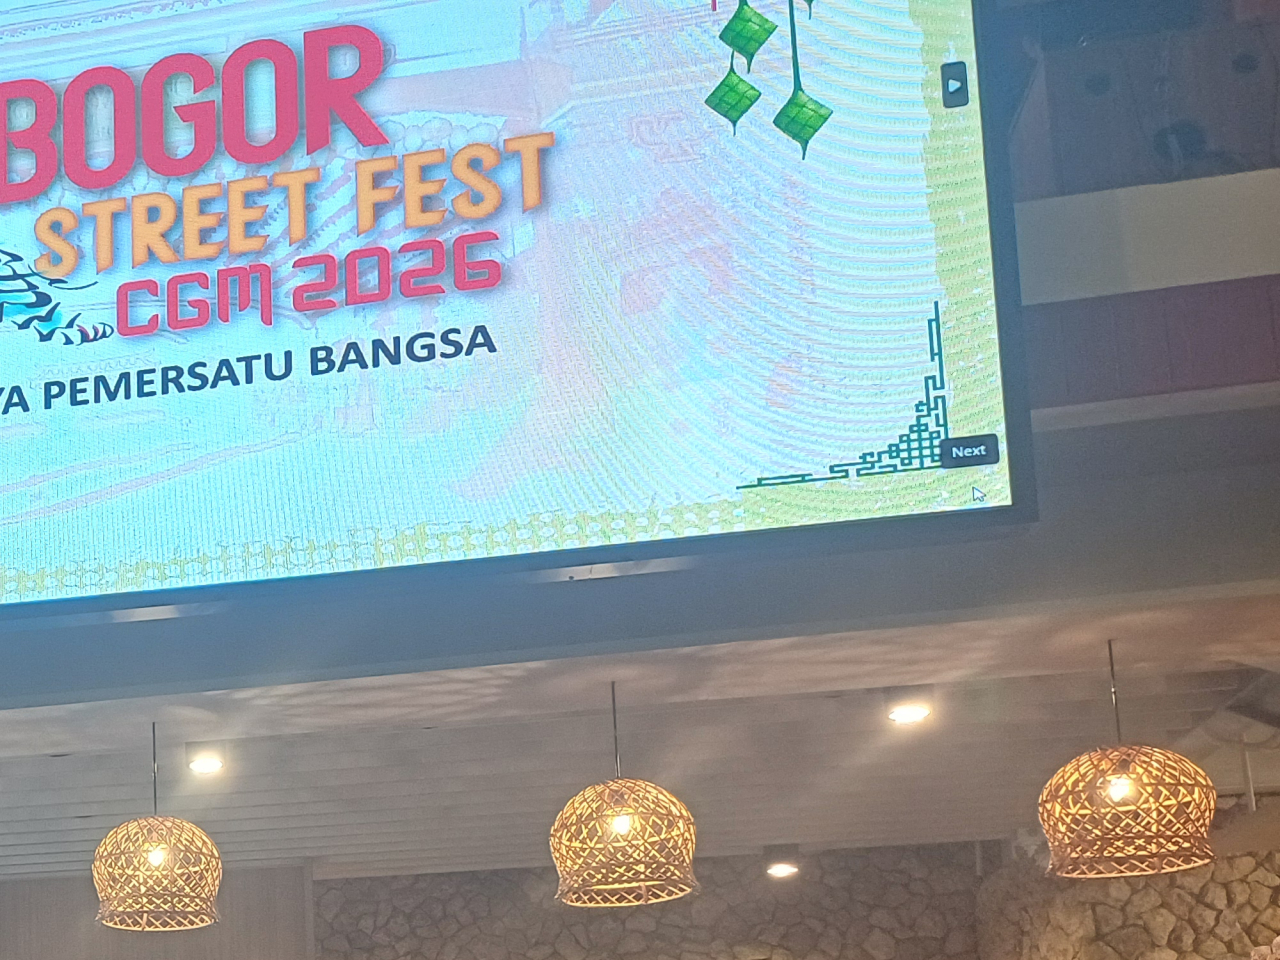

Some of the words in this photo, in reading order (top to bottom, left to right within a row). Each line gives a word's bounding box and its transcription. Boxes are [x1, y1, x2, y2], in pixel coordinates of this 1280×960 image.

[34, 167, 321, 280] STREET
[355, 131, 555, 237] FEST
[115, 262, 274, 338] CGM
[292, 230, 503, 313] 2026
[43, 350, 293, 410] PEMERSATU
[310, 324, 498, 377] BANGSA
[951, 444, 987, 458] Next
